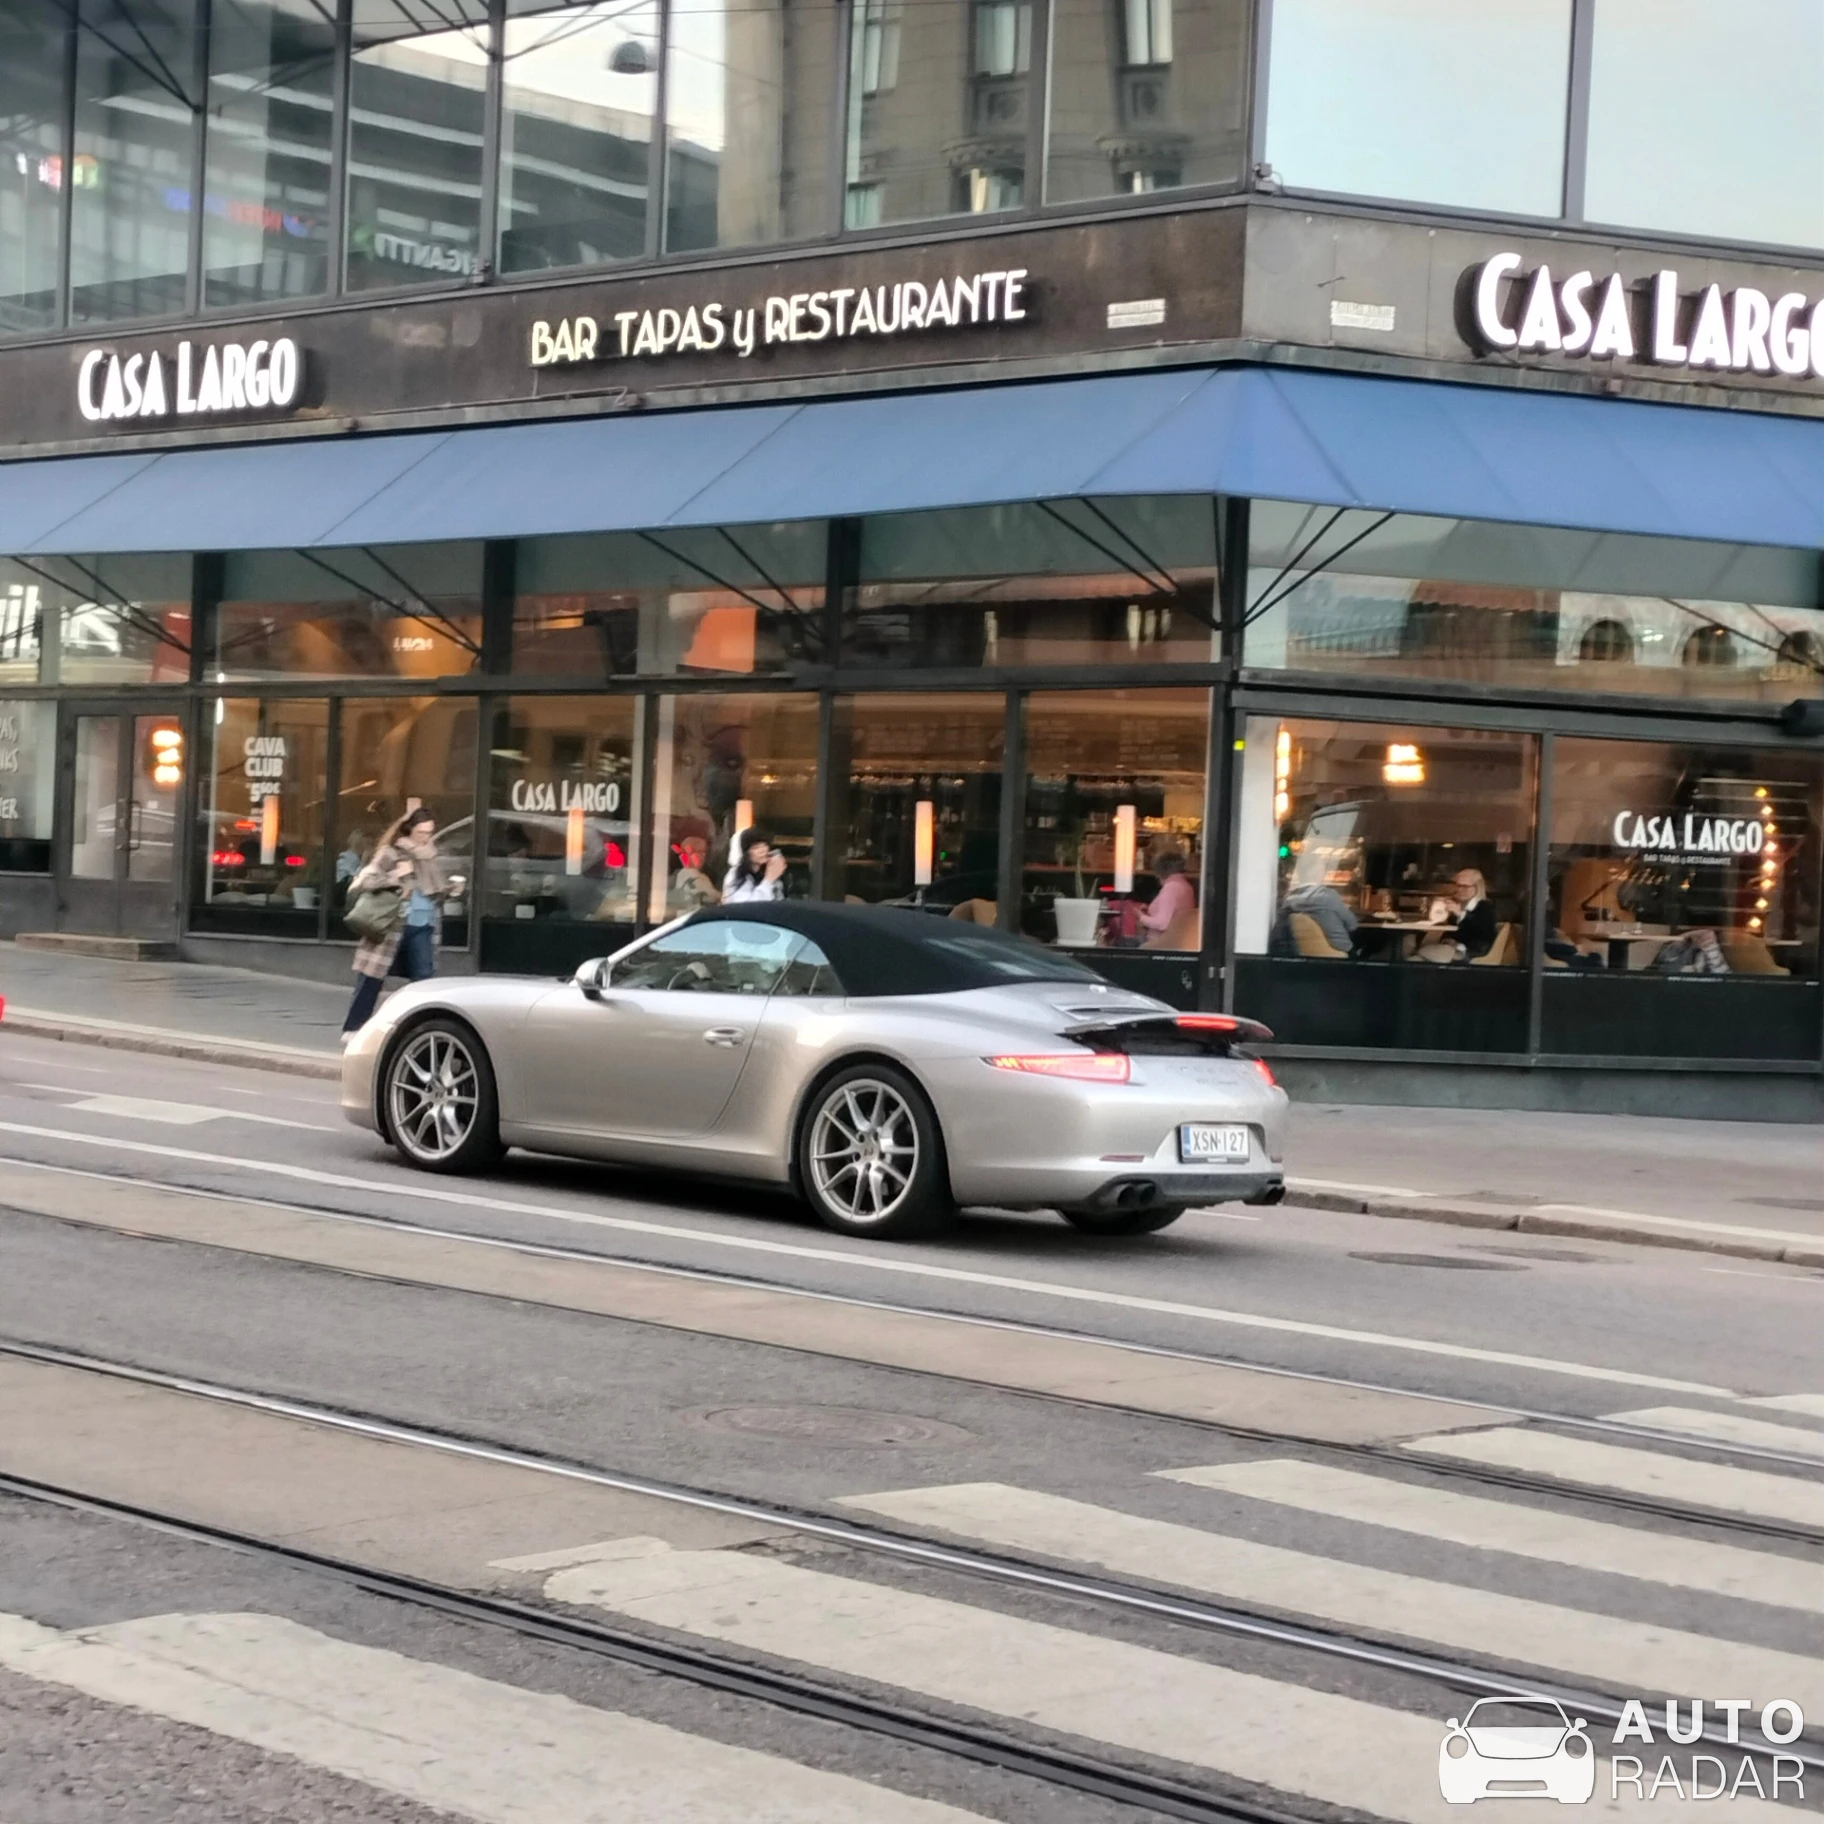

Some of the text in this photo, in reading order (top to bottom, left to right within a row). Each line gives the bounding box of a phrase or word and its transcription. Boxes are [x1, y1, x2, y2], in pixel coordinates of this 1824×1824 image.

[531, 316, 598, 365] BAR
[614, 303, 725, 356] TAPAS
[765, 269, 1028, 344] RESTAURANTE
[1477, 251, 1635, 357] CASA
[77, 337, 298, 421] CASA LARGO
[244, 736, 286, 756] CAVA
[244, 757, 283, 777] CLUB
[511, 779, 620, 813] CASA LARGO
[1613, 810, 1763, 854] CASA LARGO
[1192, 1129, 1245, 1152] XSN-127
